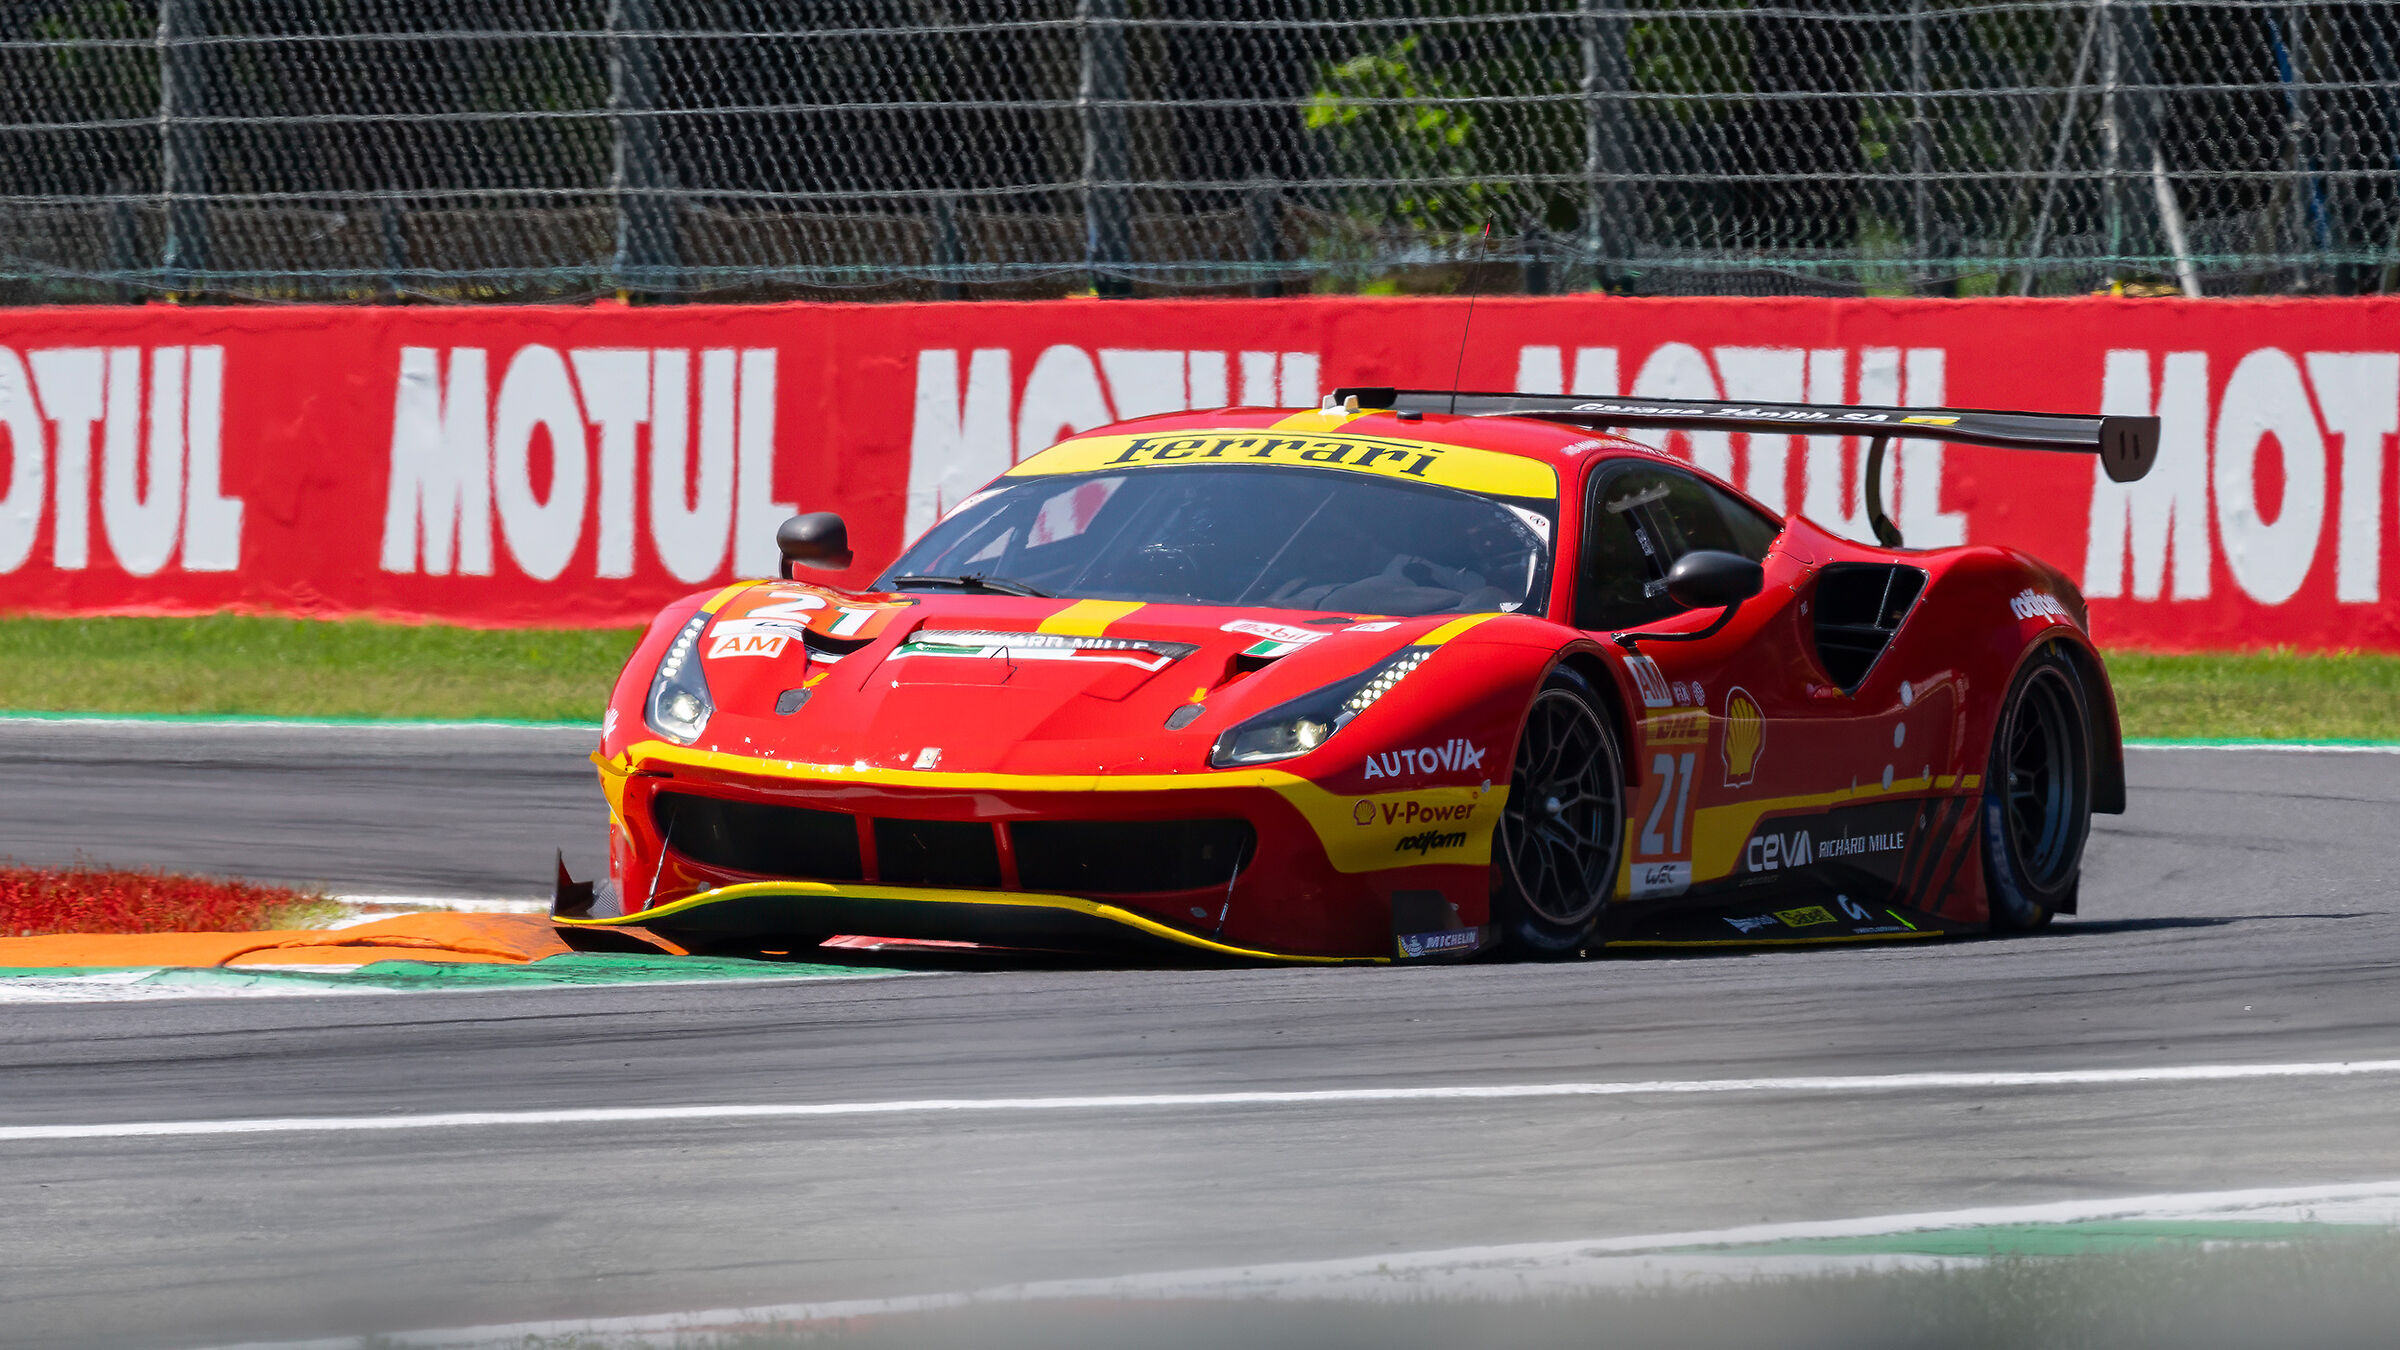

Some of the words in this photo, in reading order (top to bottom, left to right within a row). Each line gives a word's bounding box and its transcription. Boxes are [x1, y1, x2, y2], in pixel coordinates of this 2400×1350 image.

[1571, 402, 1704, 416] Garage
[1835, 412, 1889, 423] SA
[0, 344, 243, 575] OTUL
[380, 343, 799, 583] MOTUL
[1103, 433, 1445, 477] Ferrari
[1515, 341, 1968, 549] TUL
[2083, 346, 2400, 606] MOT
[745, 591, 878, 637] 21
[716, 635, 783, 653] AM
[1363, 738, 1486, 780] AUTOVIA
[1380, 800, 1477, 826] V-Power
[1640, 752, 1696, 855] 21
[1818, 836, 1866, 859] RICHARD
[1868, 831, 1905, 852] MILLE
[1425, 930, 1477, 949] MICHELIN
